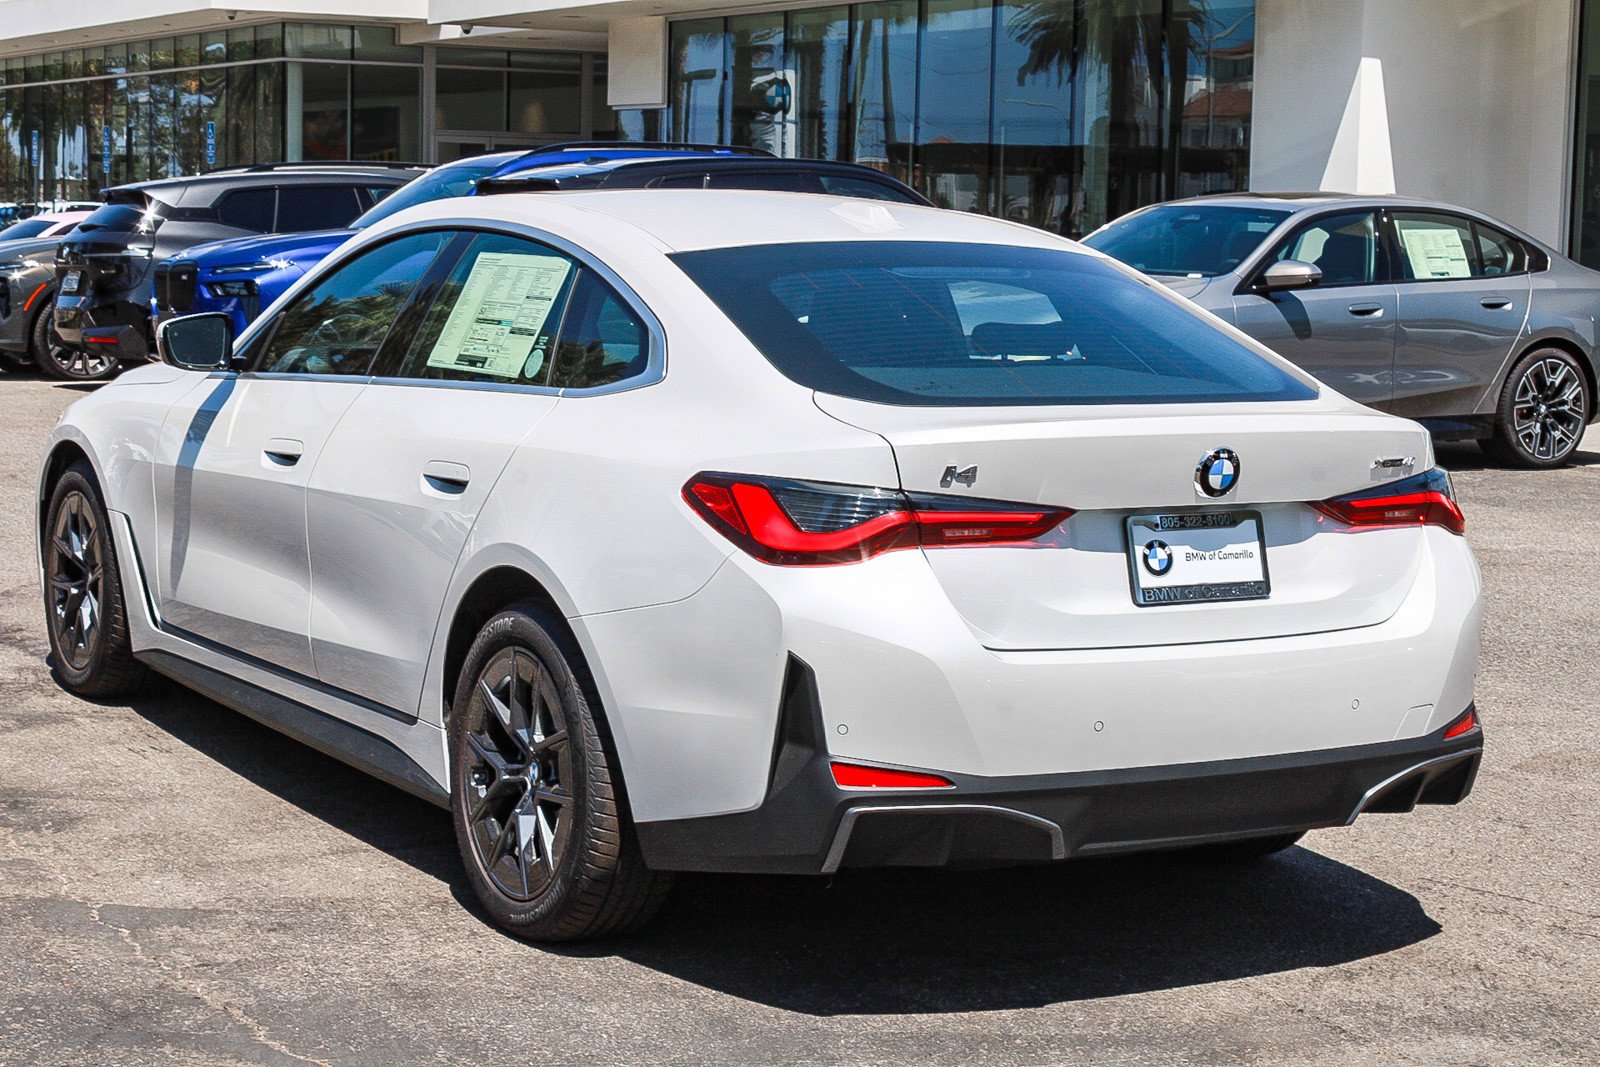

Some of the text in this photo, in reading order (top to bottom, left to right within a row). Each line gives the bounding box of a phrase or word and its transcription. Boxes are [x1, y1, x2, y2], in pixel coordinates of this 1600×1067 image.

[940, 465, 978, 488] i4
[1185, 550, 1254, 562] BMW of Camarillo
[1144, 587, 1181, 601] BMW
